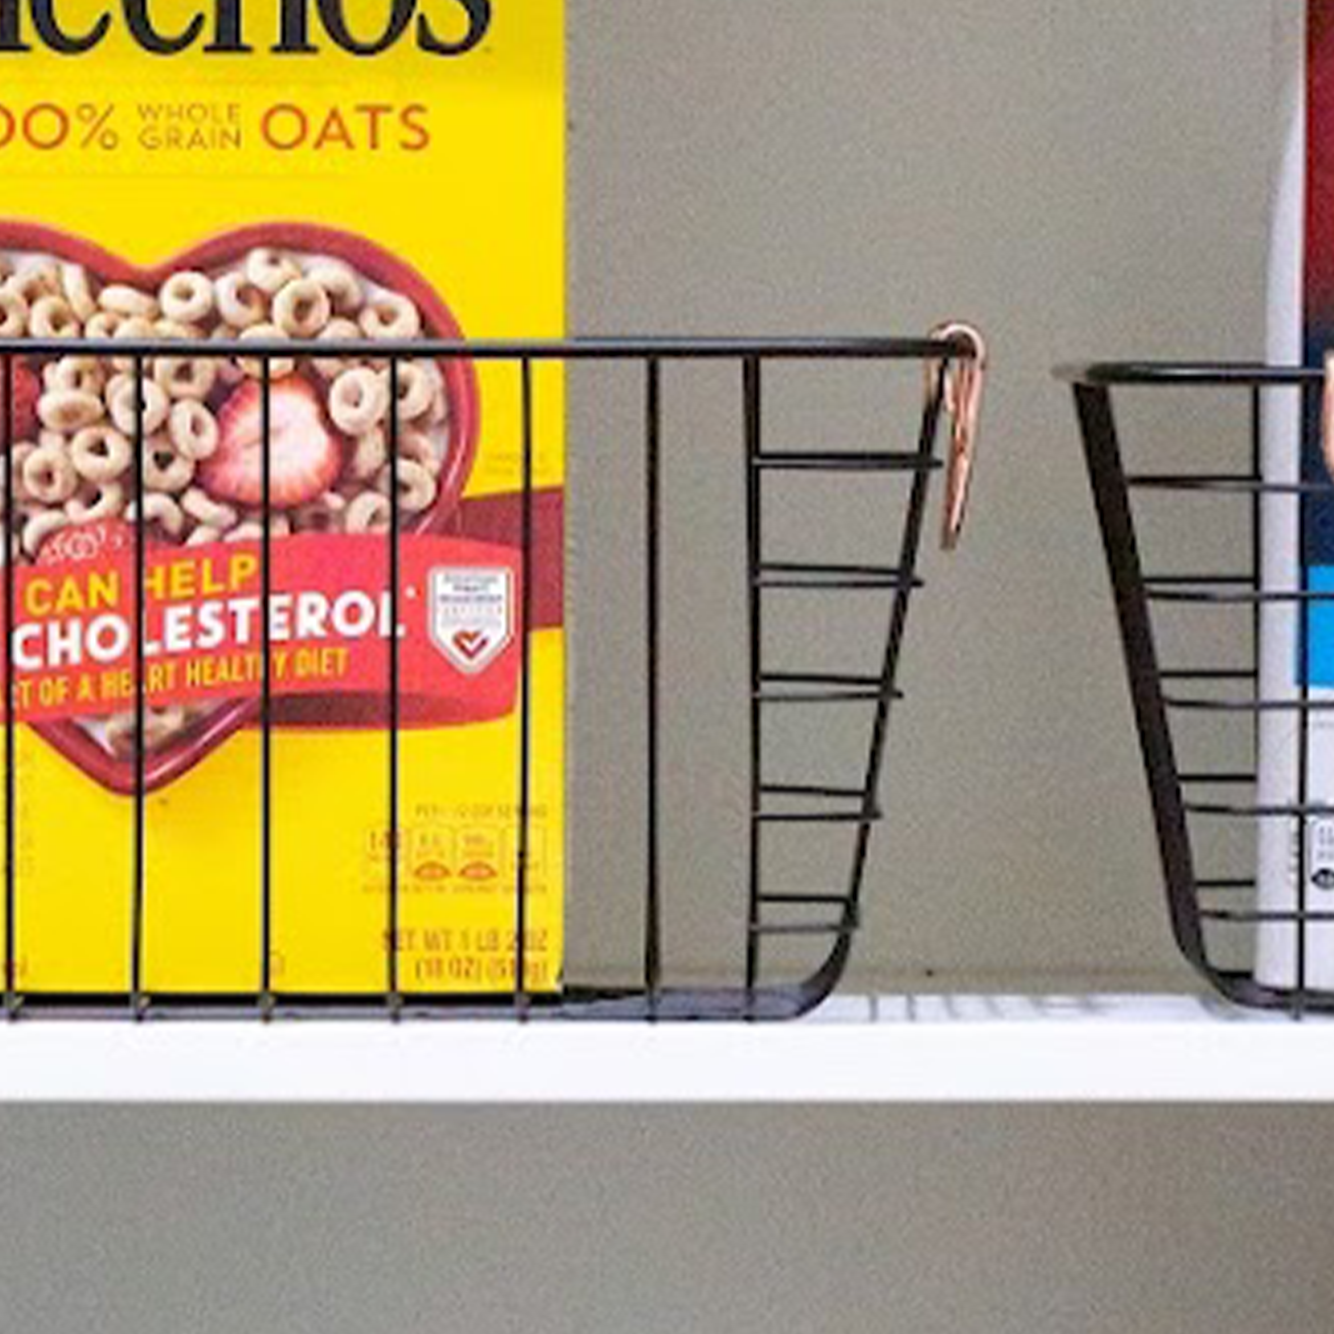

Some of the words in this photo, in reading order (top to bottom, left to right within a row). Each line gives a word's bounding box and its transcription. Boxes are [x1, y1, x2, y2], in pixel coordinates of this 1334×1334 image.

[137, 103, 243, 124] WHOLE
[137, 127, 243, 152] GRAIN
[260, 102, 431, 153] OATS
[24, 570, 122, 617] CAN
[142, 551, 259, 601] HELP
[11, 589, 407, 671] CHOLESTEROL
[38, 675, 69, 708] OF
[76, 672, 96, 704] A
[100, 663, 177, 700] HERT
[293, 646, 349, 679] DIET
